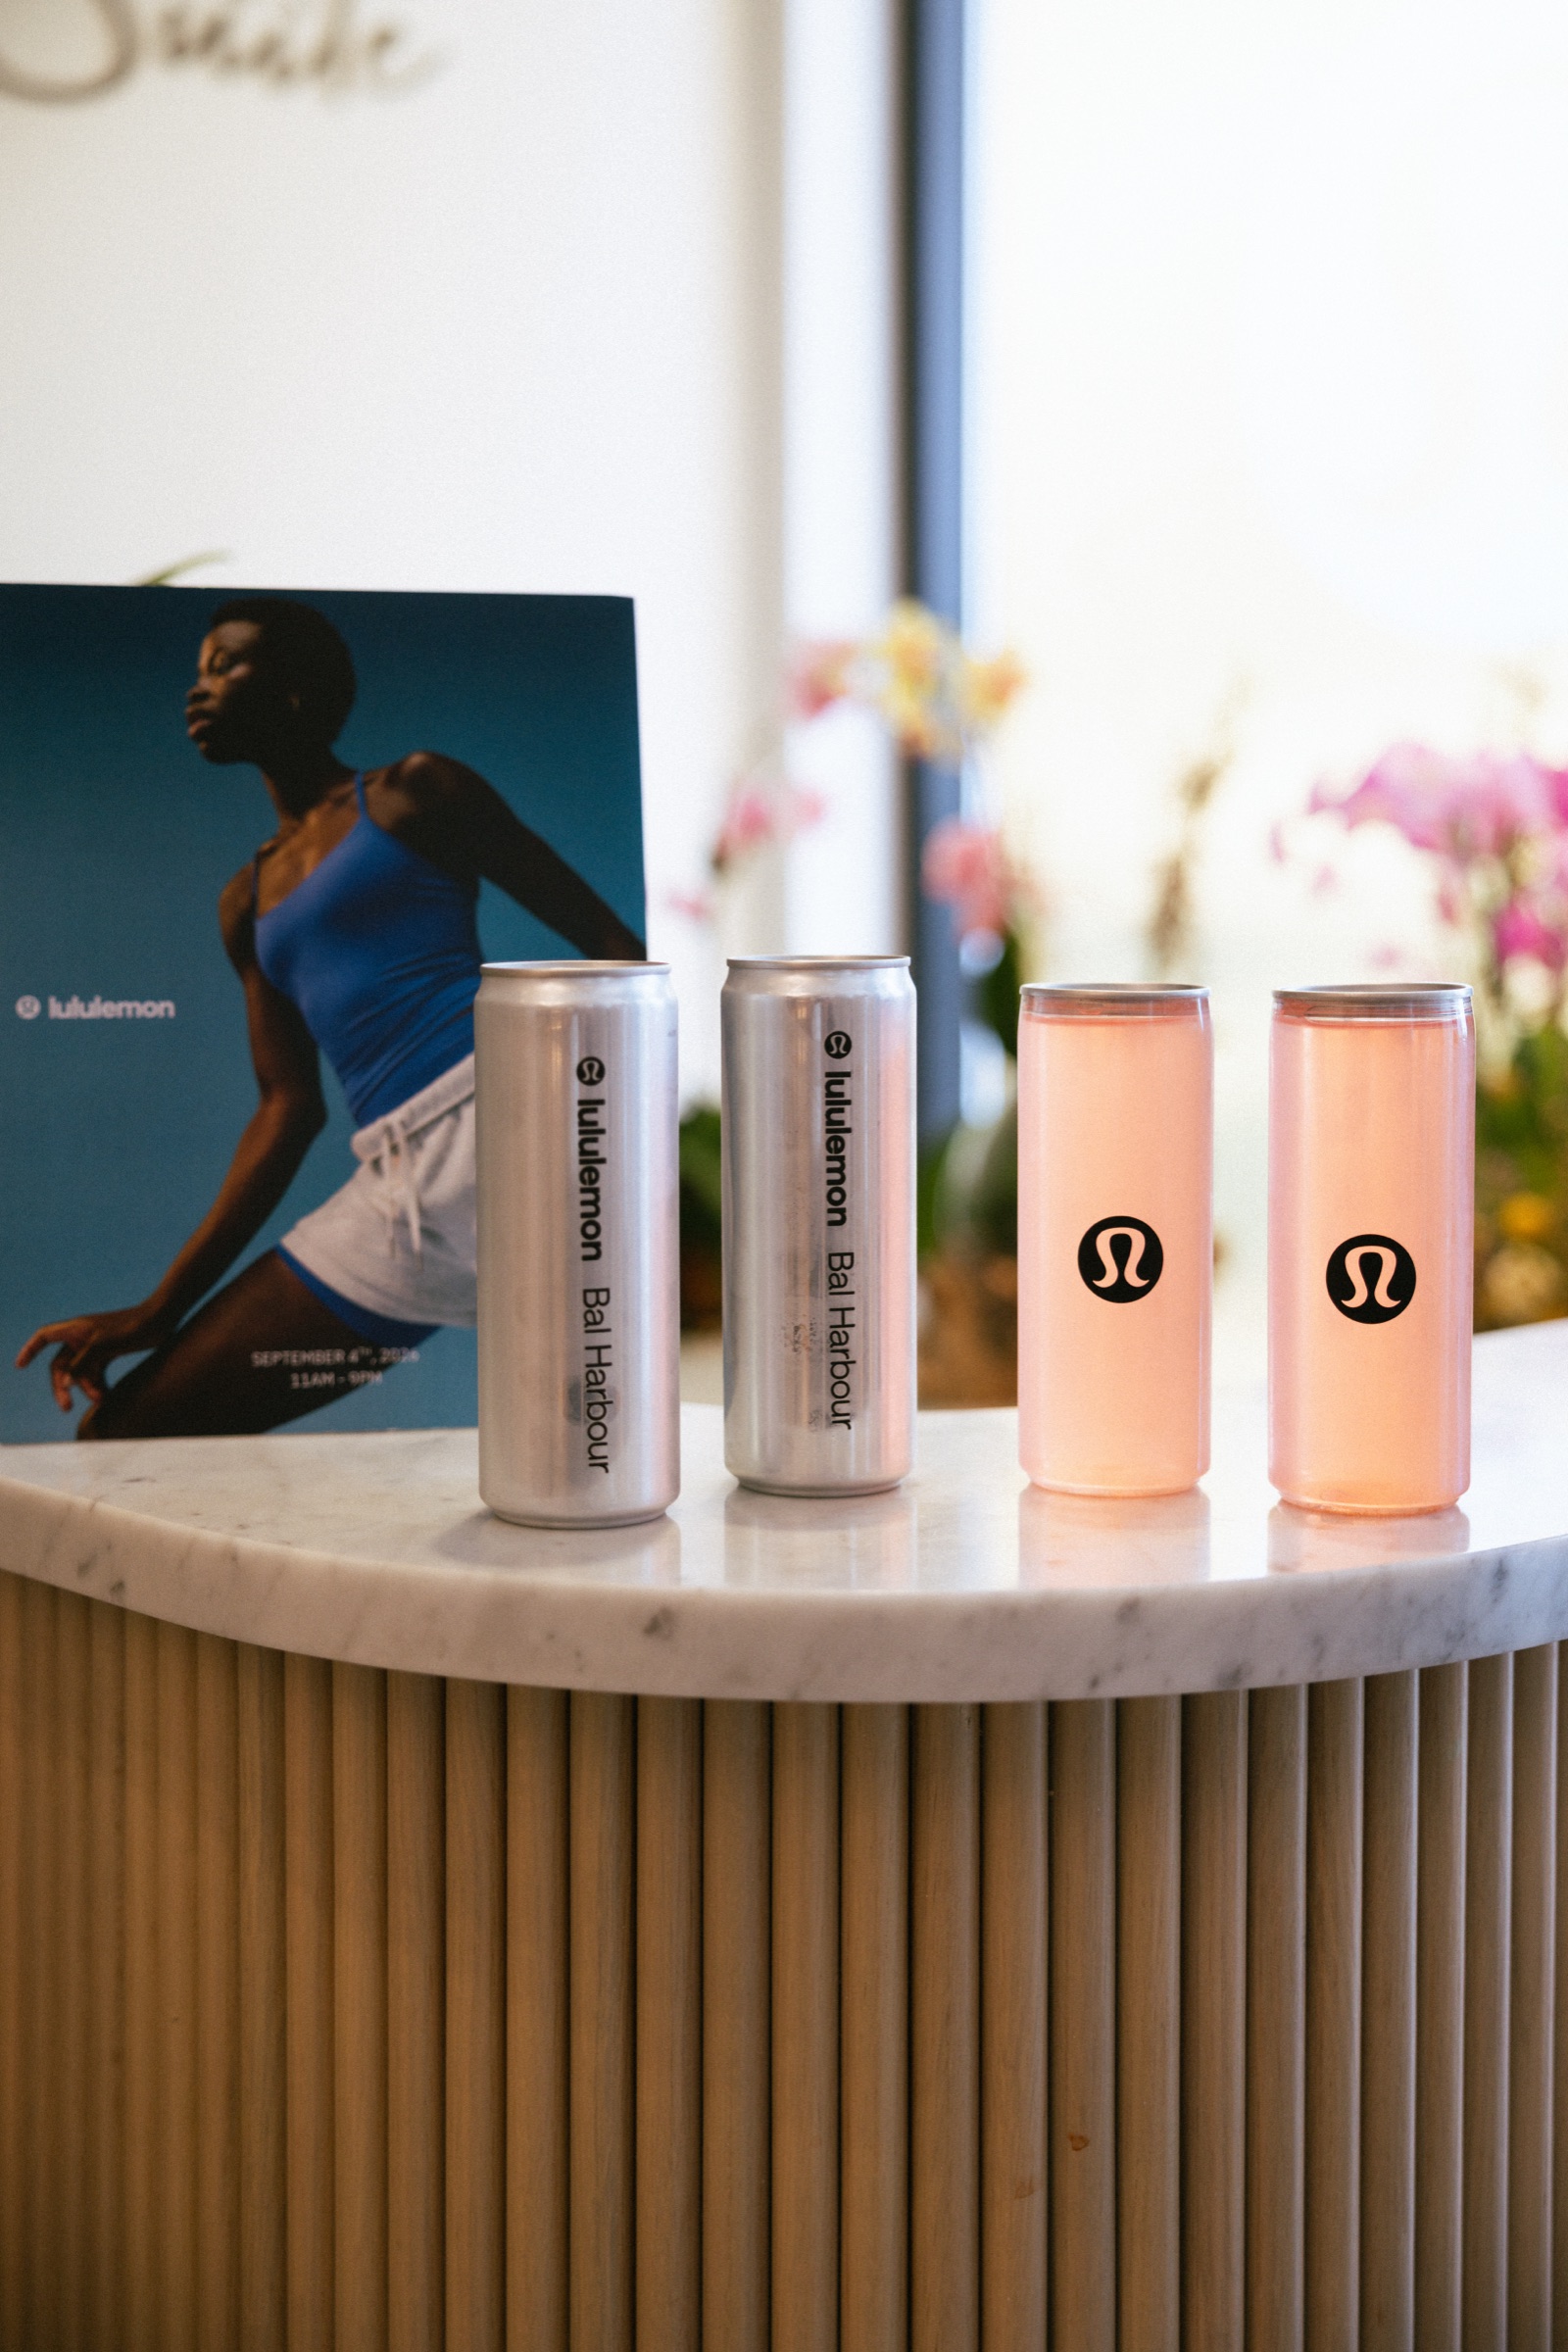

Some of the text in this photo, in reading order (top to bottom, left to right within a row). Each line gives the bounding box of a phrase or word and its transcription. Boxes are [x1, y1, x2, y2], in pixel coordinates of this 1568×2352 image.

[49, 995, 176, 1019] lululemon
[824, 1070, 857, 1430] lululemon Bal Harbour
[577, 1098, 614, 1474] lululemon Bal Harbour
[251, 1348, 345, 1367] SEPTEMBER
[291, 1372, 335, 1390] 11AM
[347, 1370, 382, 1387] 9PM
